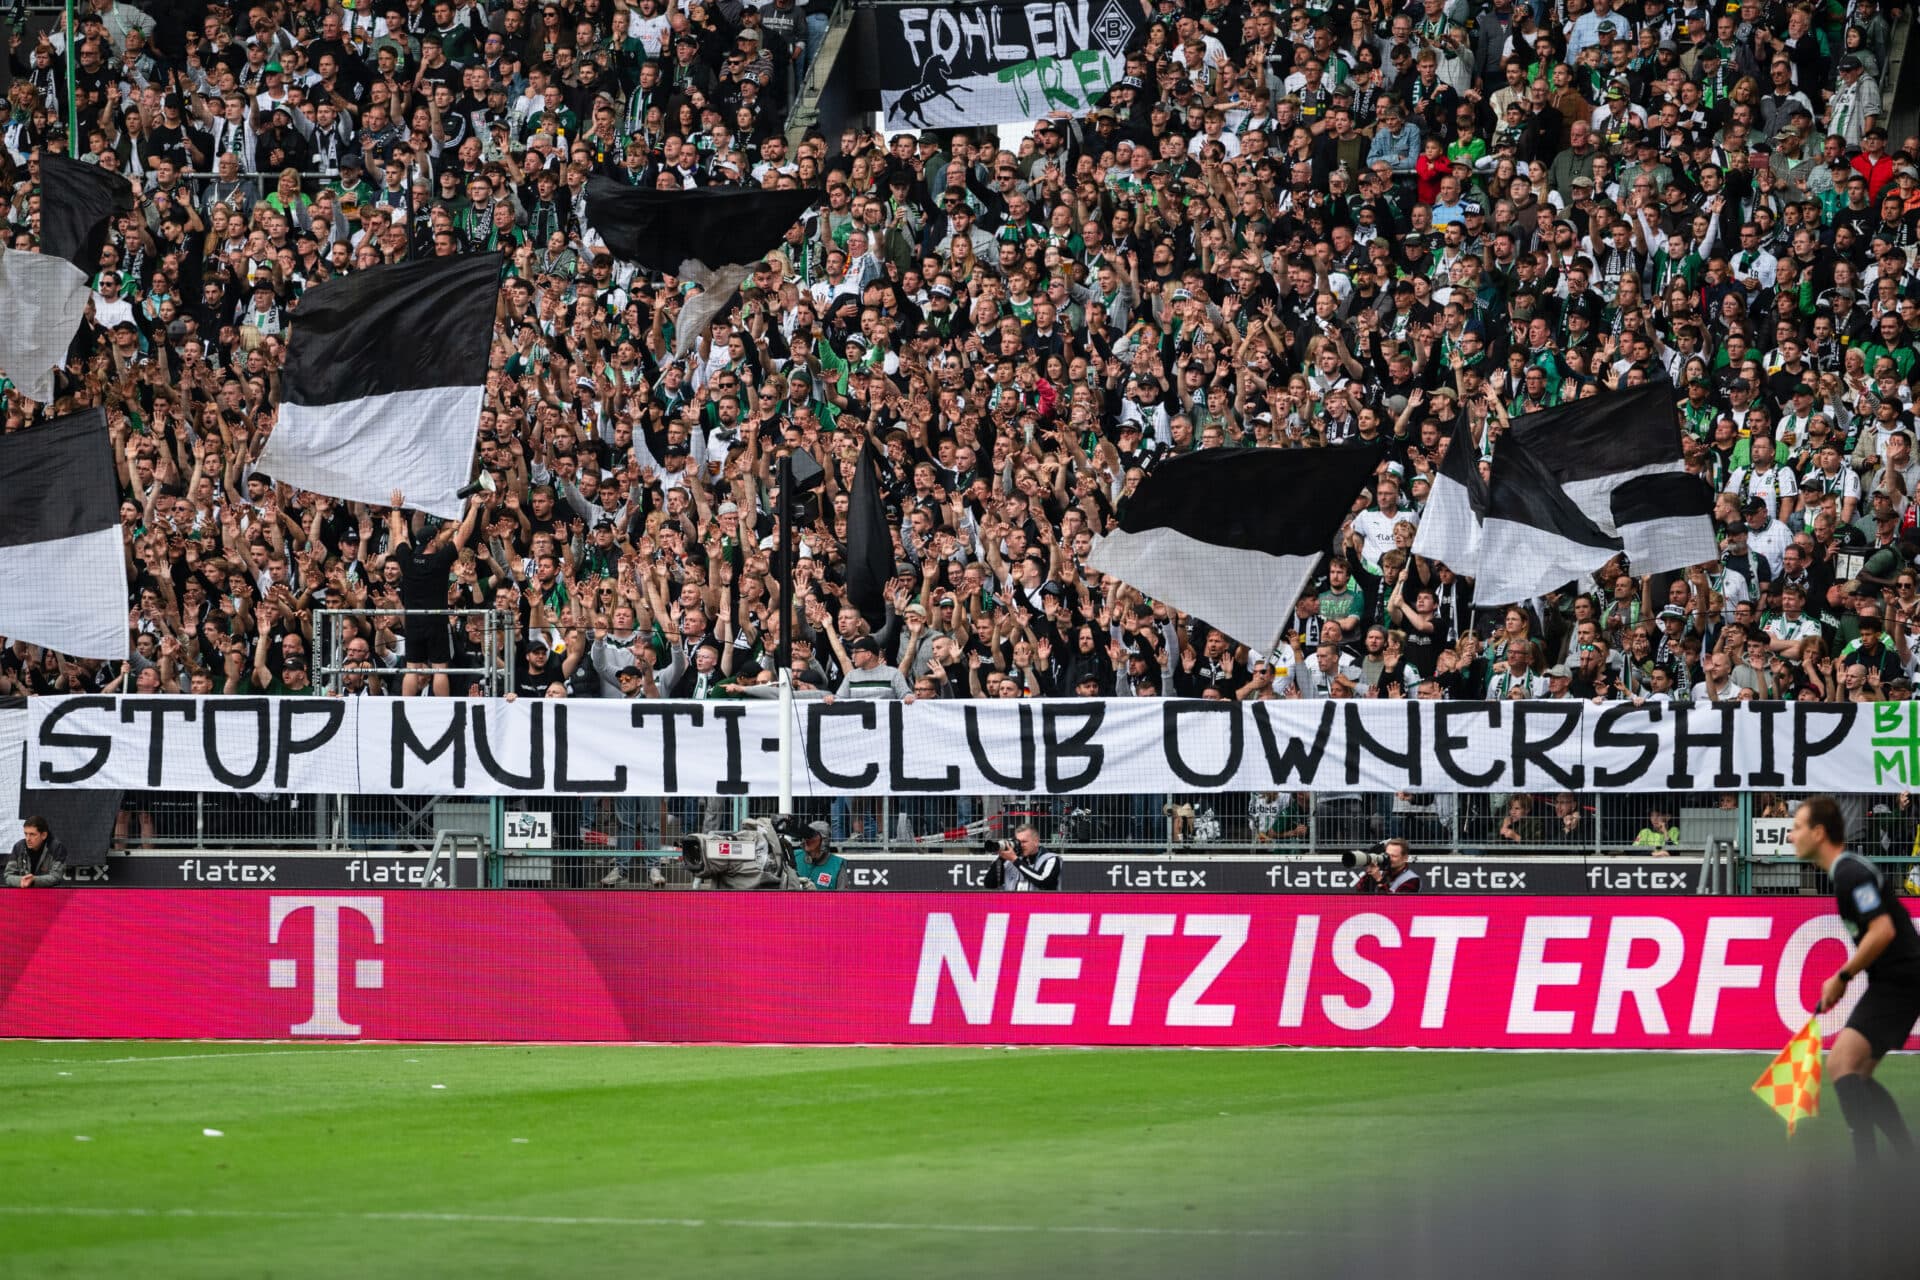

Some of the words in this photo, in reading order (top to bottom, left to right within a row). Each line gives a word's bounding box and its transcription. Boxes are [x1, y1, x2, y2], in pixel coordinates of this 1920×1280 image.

[899, 0, 1090, 67] FOHLEN
[1105, 18, 1124, 39] B
[39, 698, 345, 788] STOP
[391, 700, 1106, 794] MULTI-CLUB
[1163, 700, 1858, 789] OWNERSHIP
[508, 821, 548, 839] 15/1
[1755, 827, 1794, 847] 15/
[908, 912, 1252, 1027] NETZ
[1278, 912, 1489, 1031] IST
[1506, 914, 1920, 1038] ERFO
